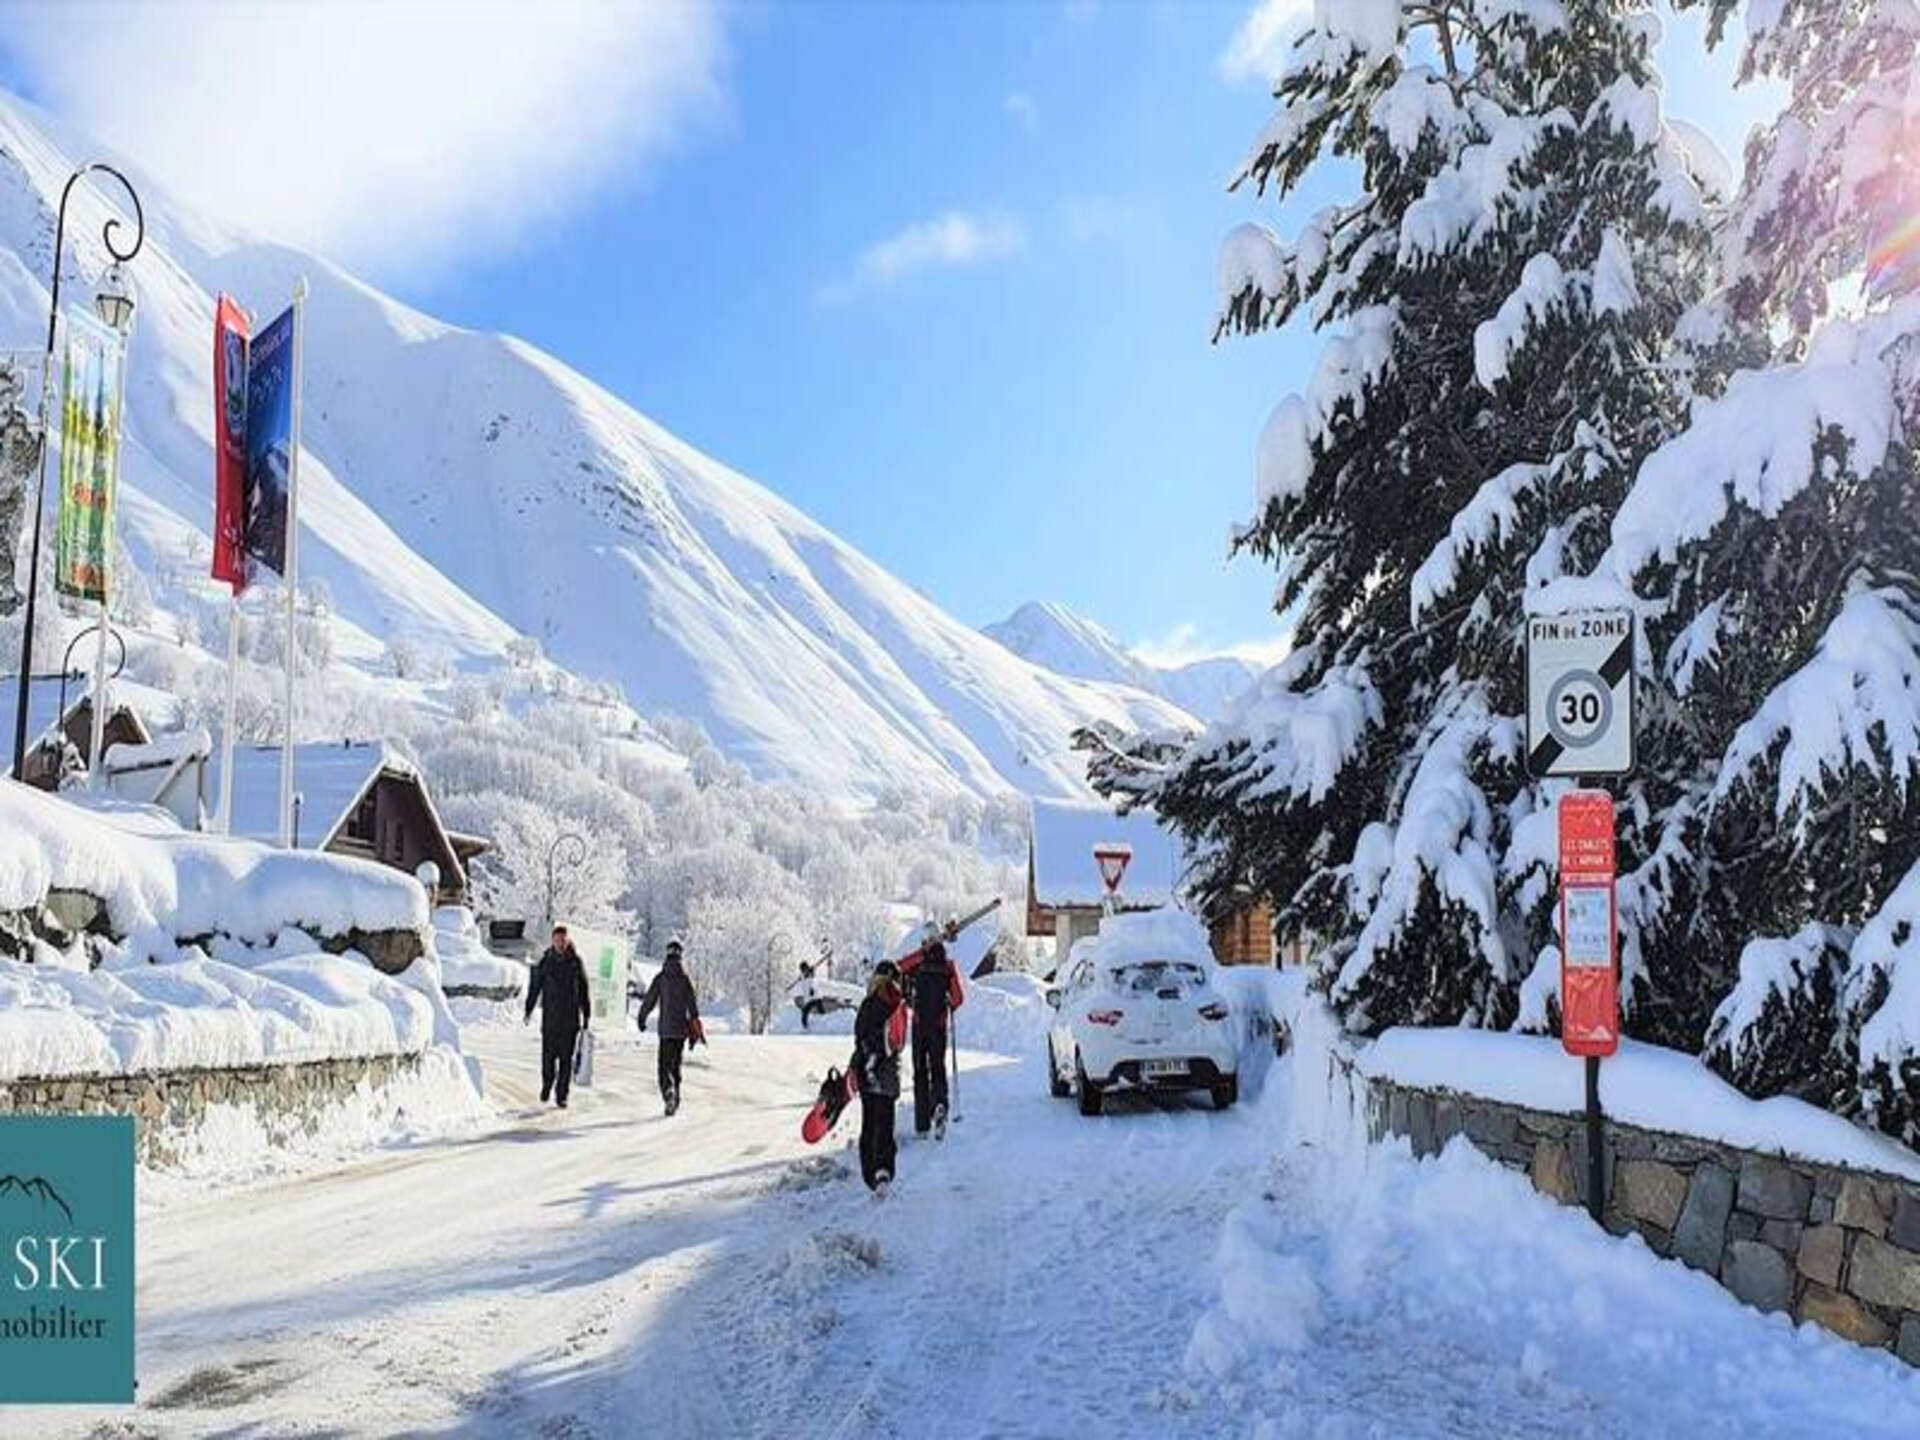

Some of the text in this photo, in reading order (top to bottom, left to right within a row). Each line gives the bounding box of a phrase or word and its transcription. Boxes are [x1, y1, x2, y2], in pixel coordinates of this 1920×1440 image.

[1532, 623, 1559, 641] FIN
[1581, 618, 1626, 637] ZONE
[1561, 694, 1599, 724] 30
